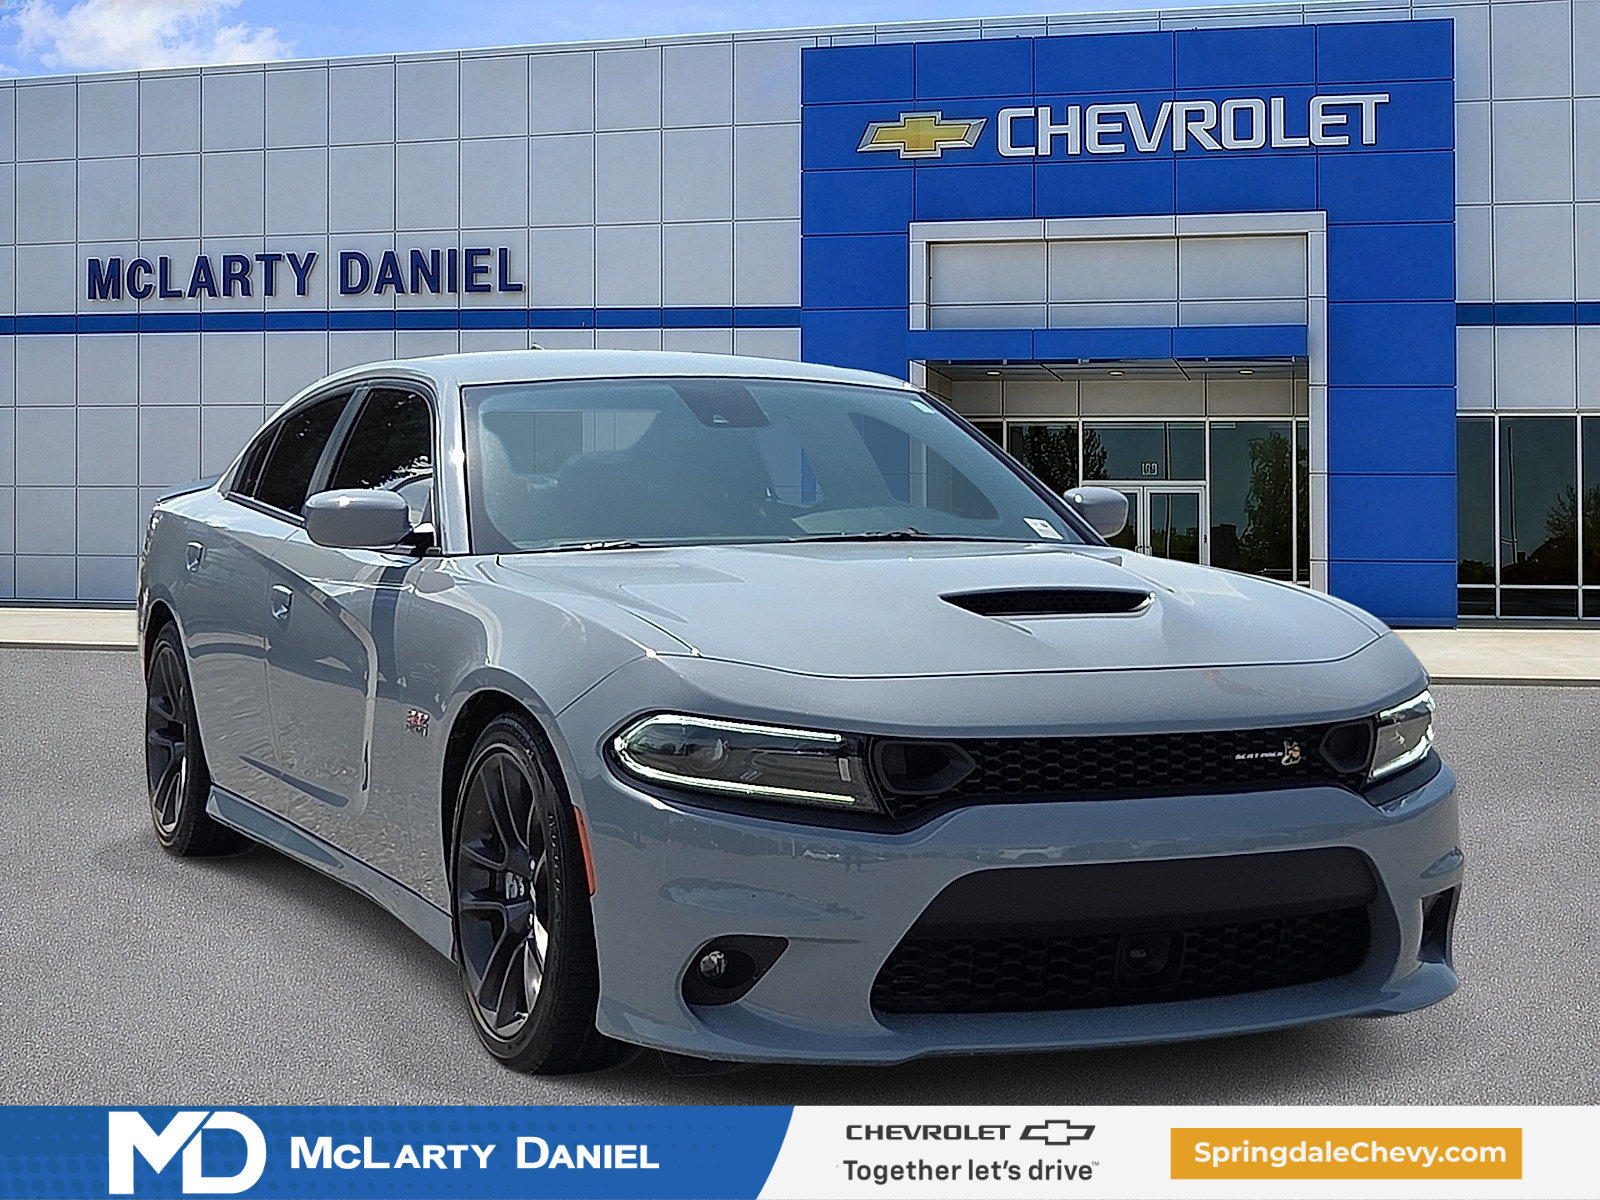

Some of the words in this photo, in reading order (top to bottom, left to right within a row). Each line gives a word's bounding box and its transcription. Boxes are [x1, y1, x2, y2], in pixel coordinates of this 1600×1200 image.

[997, 94, 1390, 157] CHEVROLET
[87, 252, 319, 300] MCLARTY
[339, 247, 525, 295] DANIEL
